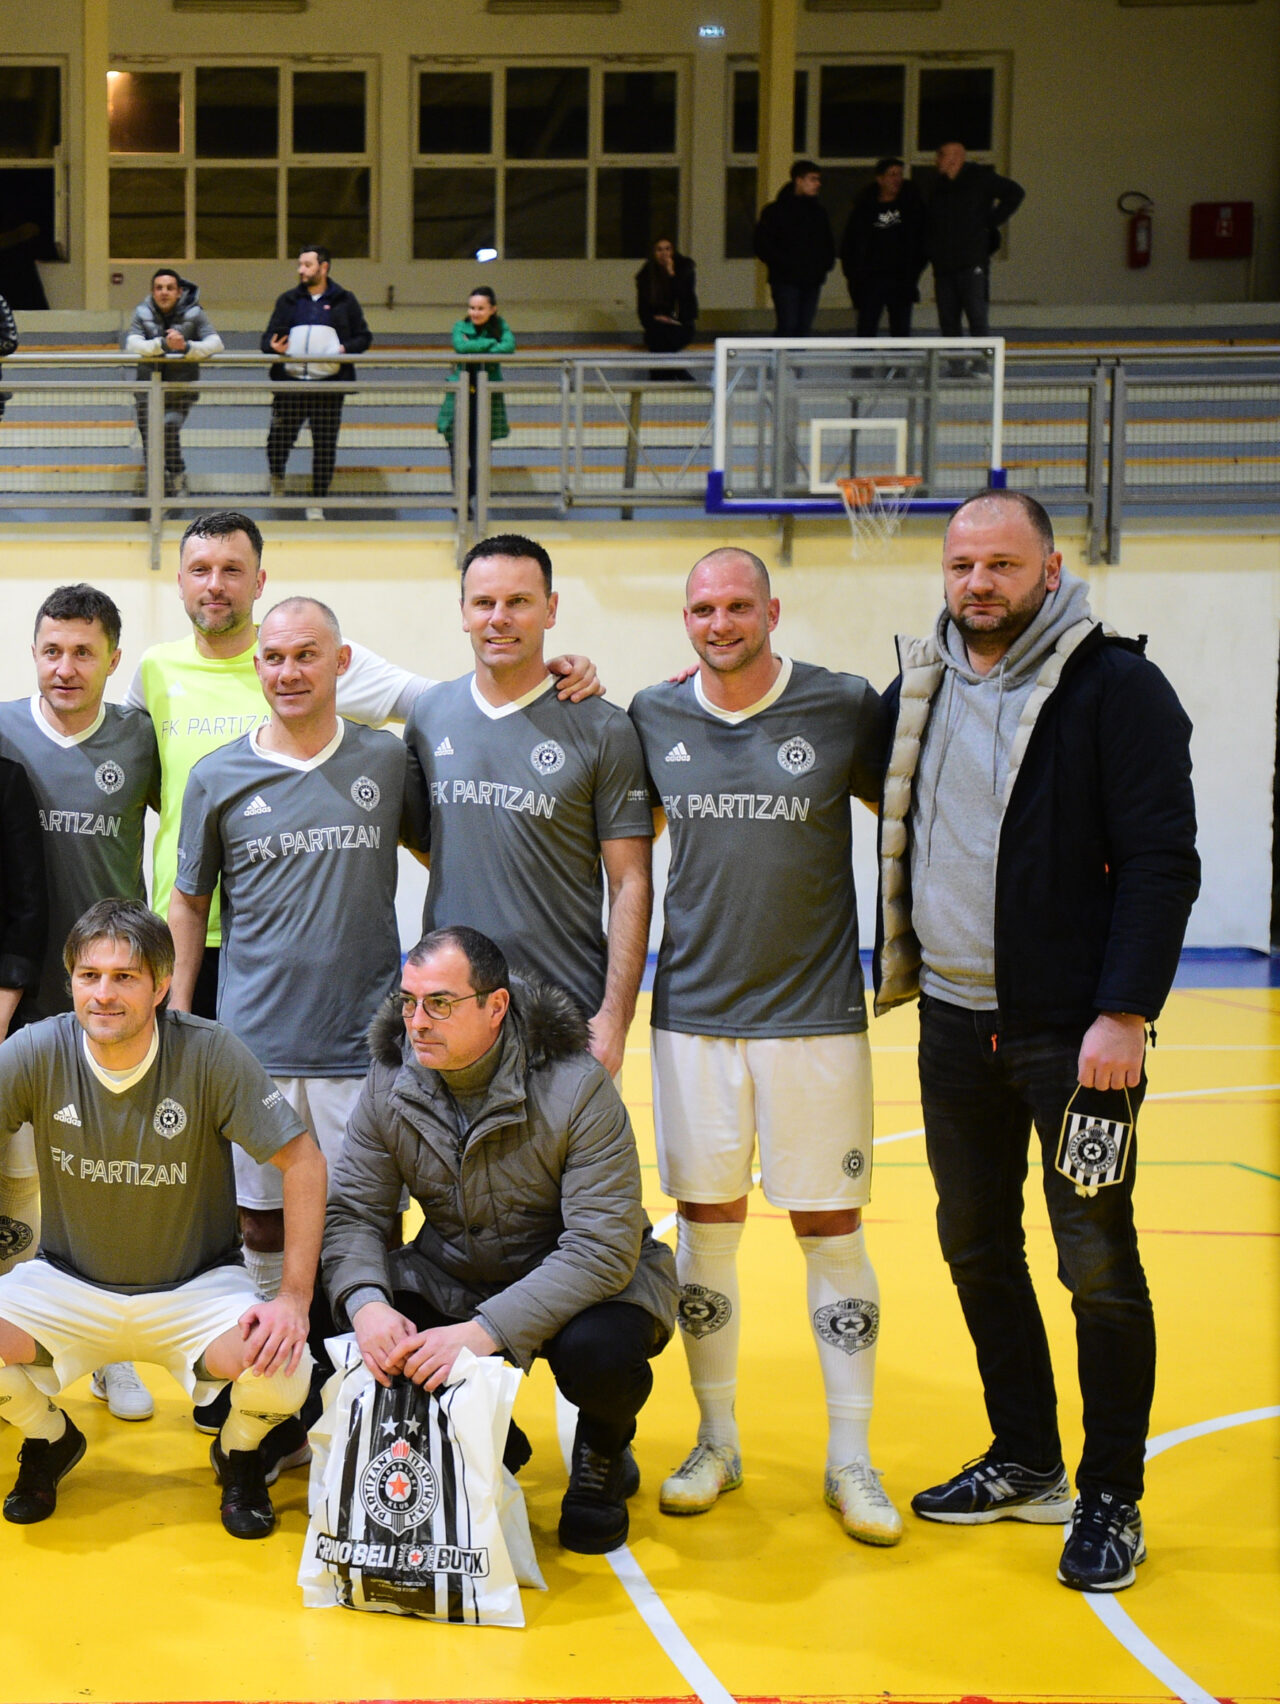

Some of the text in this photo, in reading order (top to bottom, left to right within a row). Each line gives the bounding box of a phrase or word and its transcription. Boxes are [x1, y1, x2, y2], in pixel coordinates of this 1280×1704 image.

[161, 714, 269, 740] FK PARTIZ
[665, 755, 691, 763] adidas
[244, 806, 272, 817] adidas
[430, 780, 557, 820] FK PARTIZAN
[662, 794, 811, 821] FK PARTIZAN
[38, 809, 122, 838] ARTIZAN
[246, 825, 380, 863] FK PARTIZAN
[53, 1113, 82, 1127] adidas
[81, 1158, 187, 1187] PARTIZAN
[365, 1456, 388, 1521] PARTIZAN
[409, 1456, 434, 1522] ПАРТИЗАН
[387, 1501, 410, 1510] KLUB
[437, 1548, 483, 1573] BUTIK
